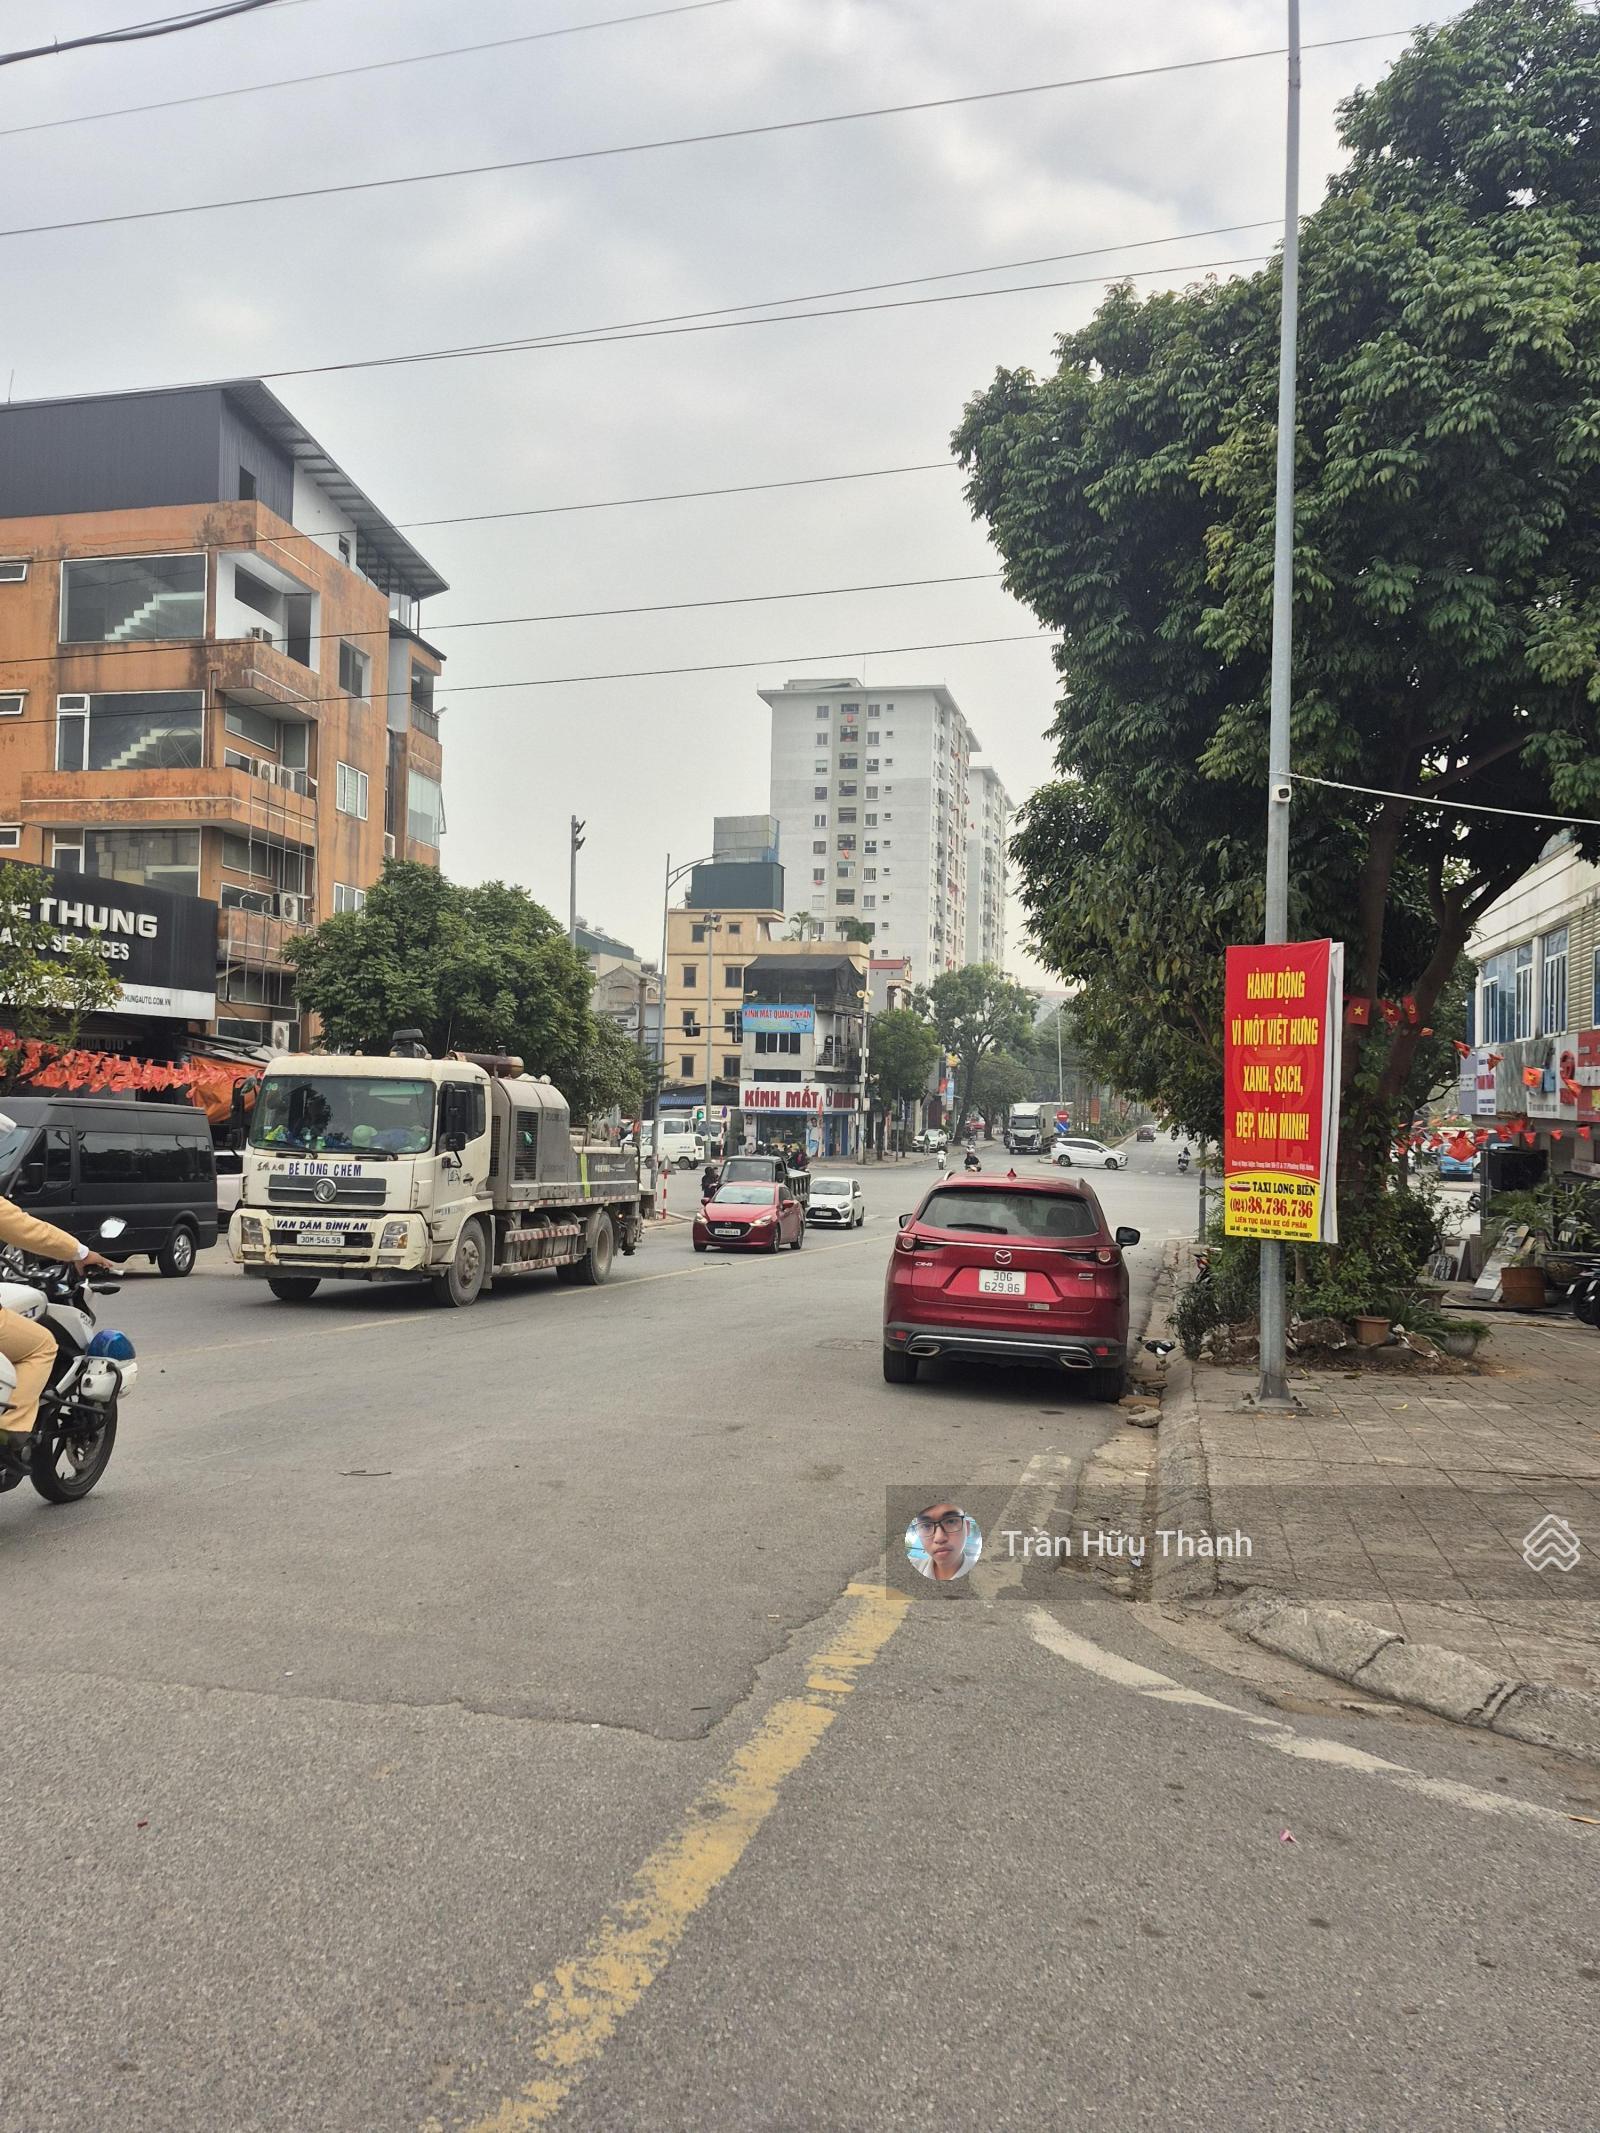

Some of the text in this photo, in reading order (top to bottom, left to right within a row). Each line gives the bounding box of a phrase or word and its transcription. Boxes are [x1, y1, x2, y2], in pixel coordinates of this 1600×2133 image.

[1247, 966, 1305, 1004] HÀNH ĐỘNG
[1232, 1013, 1319, 1051] VÌ MỘT VIỆT HƯNG
[1243, 1065, 1304, 1099] XANH, SẠCH,
[745, 1087, 780, 1107] KÍNH
[786, 1085, 819, 1108] MẮT
[1236, 1106, 1310, 1144] ĐẸP, VĂN MINH!
[304, 1161, 329, 1175] TÔNG
[1252, 1181, 1316, 1196] TAXI LONG BIÊN
[353, 1222, 368, 1231] AN
[1235, 1216, 1247, 1224] LIÊN
[1248, 1218, 1258, 1226] TỤC
[992, 1270, 1014, 1282] 30G
[984, 1281, 1020, 1293] 629.86
